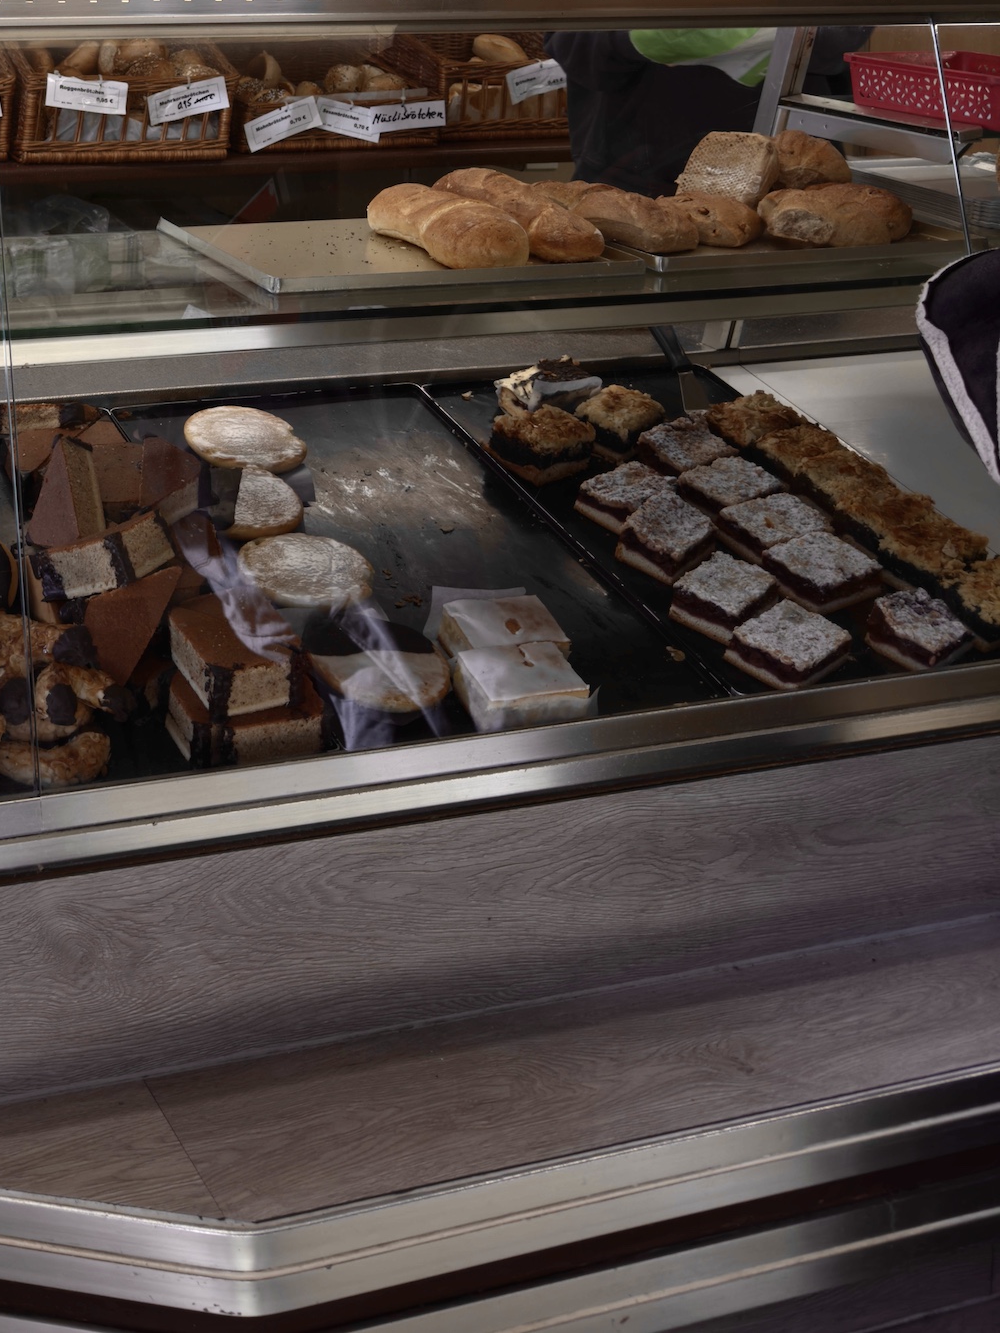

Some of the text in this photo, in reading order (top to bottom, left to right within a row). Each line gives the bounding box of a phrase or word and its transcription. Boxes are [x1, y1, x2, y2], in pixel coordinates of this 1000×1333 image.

[59, 84, 105, 95] Roggenbrötchen
[159, 89, 210, 106] Mehrkornbrötchen
[289, 117, 302, 125] 0,70
[322, 108, 360, 122] Sesambrötchen
[255, 114, 291, 132] Mohnbrötchen
